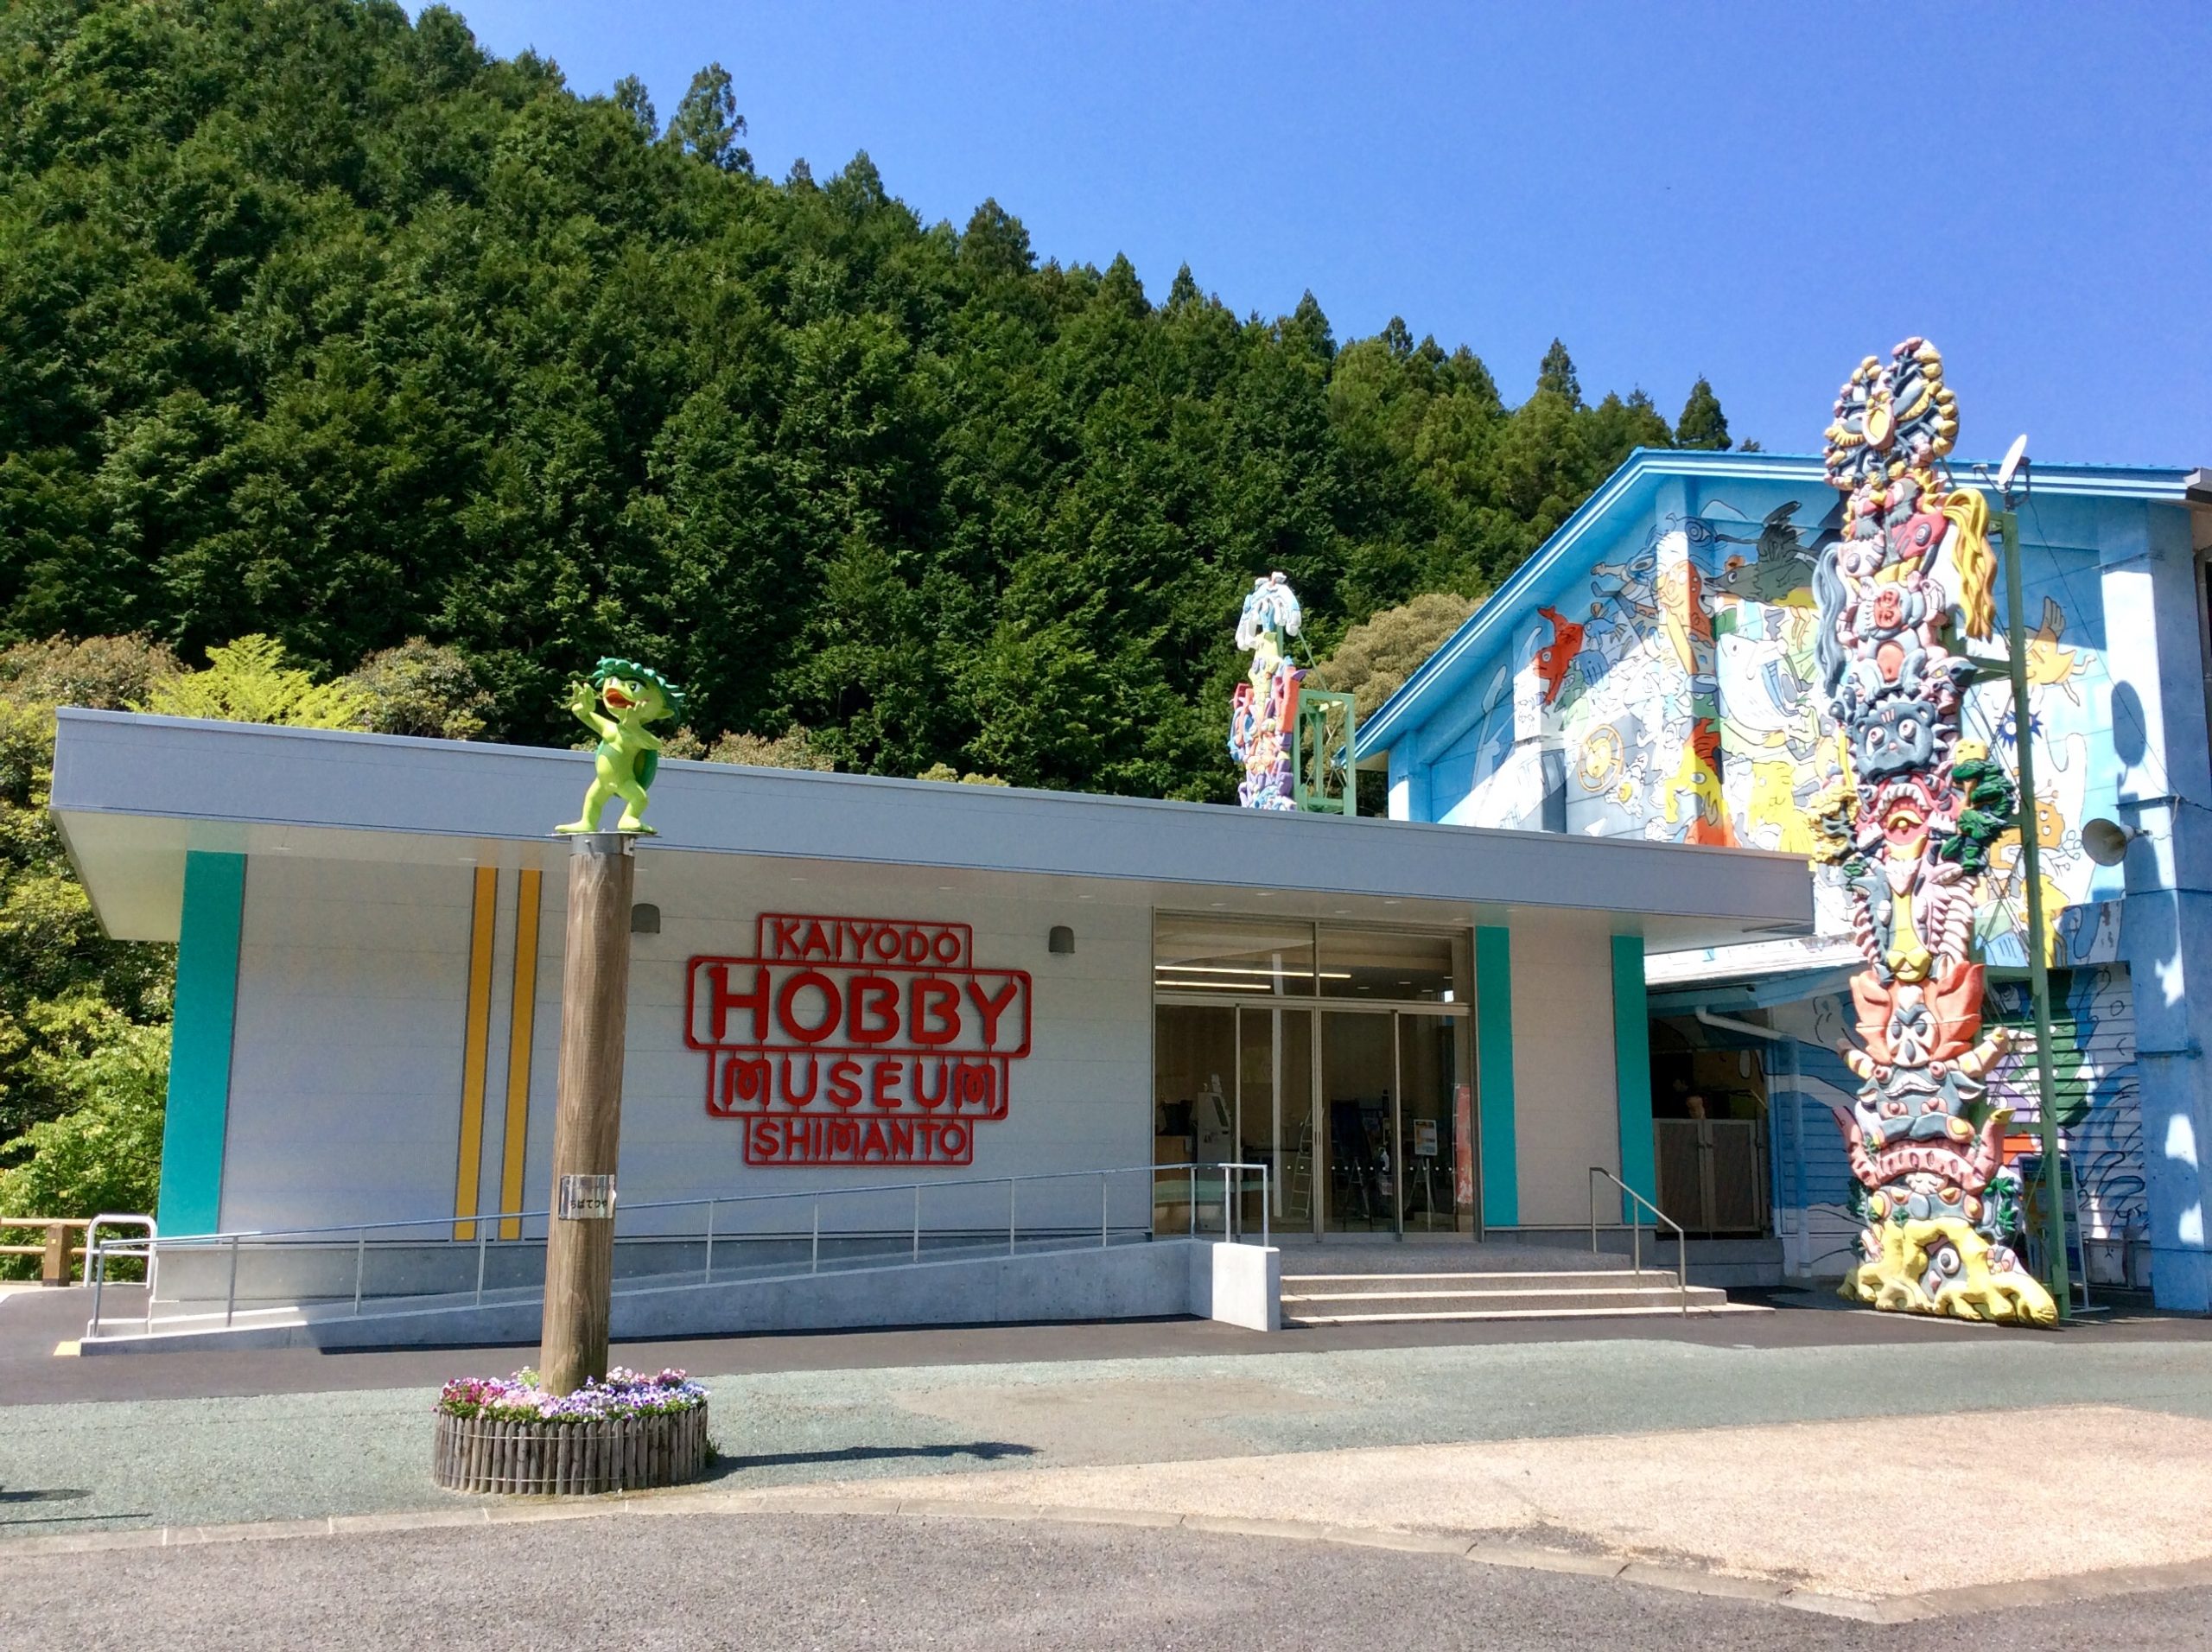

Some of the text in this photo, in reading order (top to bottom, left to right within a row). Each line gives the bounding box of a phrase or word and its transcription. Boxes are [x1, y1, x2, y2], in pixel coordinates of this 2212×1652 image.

[774, 919, 960, 963] KAIYODO
[708, 967, 1017, 1045] HOBBY
[724, 1058, 995, 1109] MUSEUM
[753, 1122, 967, 1157] SHIMANTO
